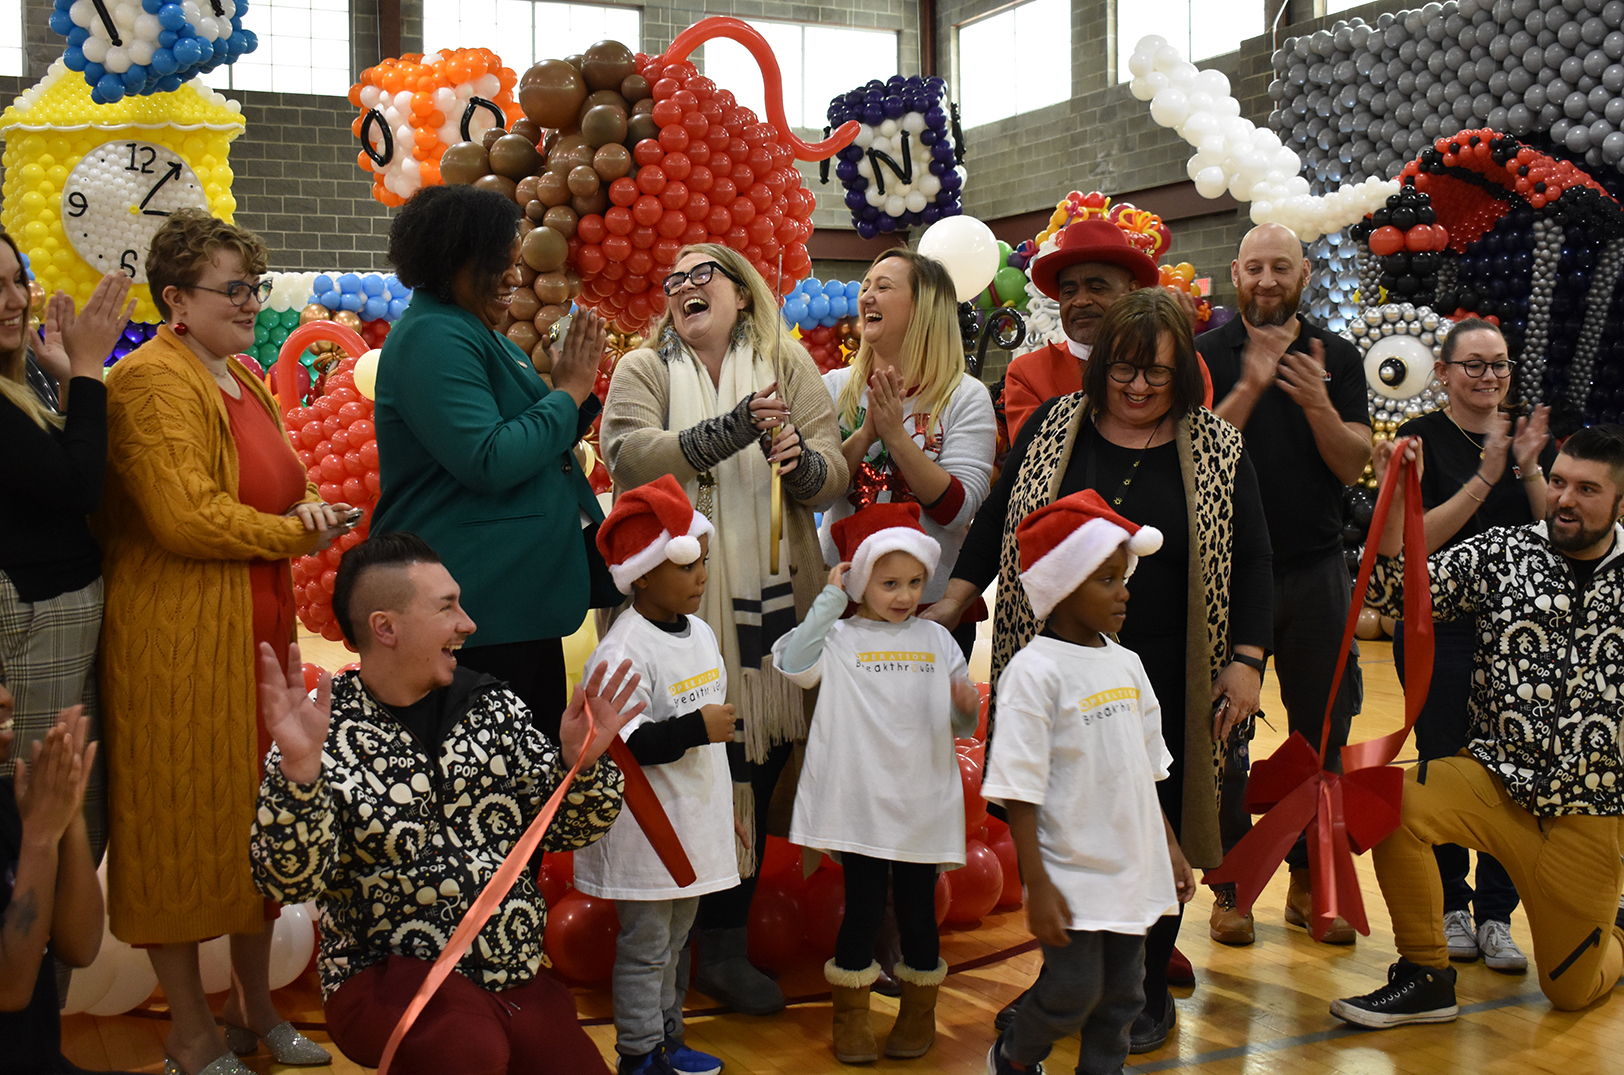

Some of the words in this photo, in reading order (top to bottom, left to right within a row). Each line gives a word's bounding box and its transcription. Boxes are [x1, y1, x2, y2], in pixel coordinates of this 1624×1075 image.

[125, 143, 156, 174] 12
[866, 130, 912, 195] N
[68, 191, 88, 217] 9
[121, 249, 138, 278] 6
[1544, 577, 1565, 590] POP
[1507, 586, 1523, 600] POP
[1590, 600, 1611, 613] POP
[857, 653, 927, 661] OPERATION
[1530, 663, 1550, 678] POP
[670, 671, 717, 695] OPERATION
[1574, 687, 1594, 700] POP
[1604, 705, 1616, 713] HE
[1474, 747, 1492, 762] POP
[1516, 748, 1535, 765] POP
[1600, 755, 1617, 767] POP
[389, 755, 415, 769] POP
[454, 764, 478, 778] POP
[1555, 769, 1574, 783] POP
[405, 807, 419, 819] HE
[373, 889, 400, 904] POP
[424, 906, 440, 918] HE
